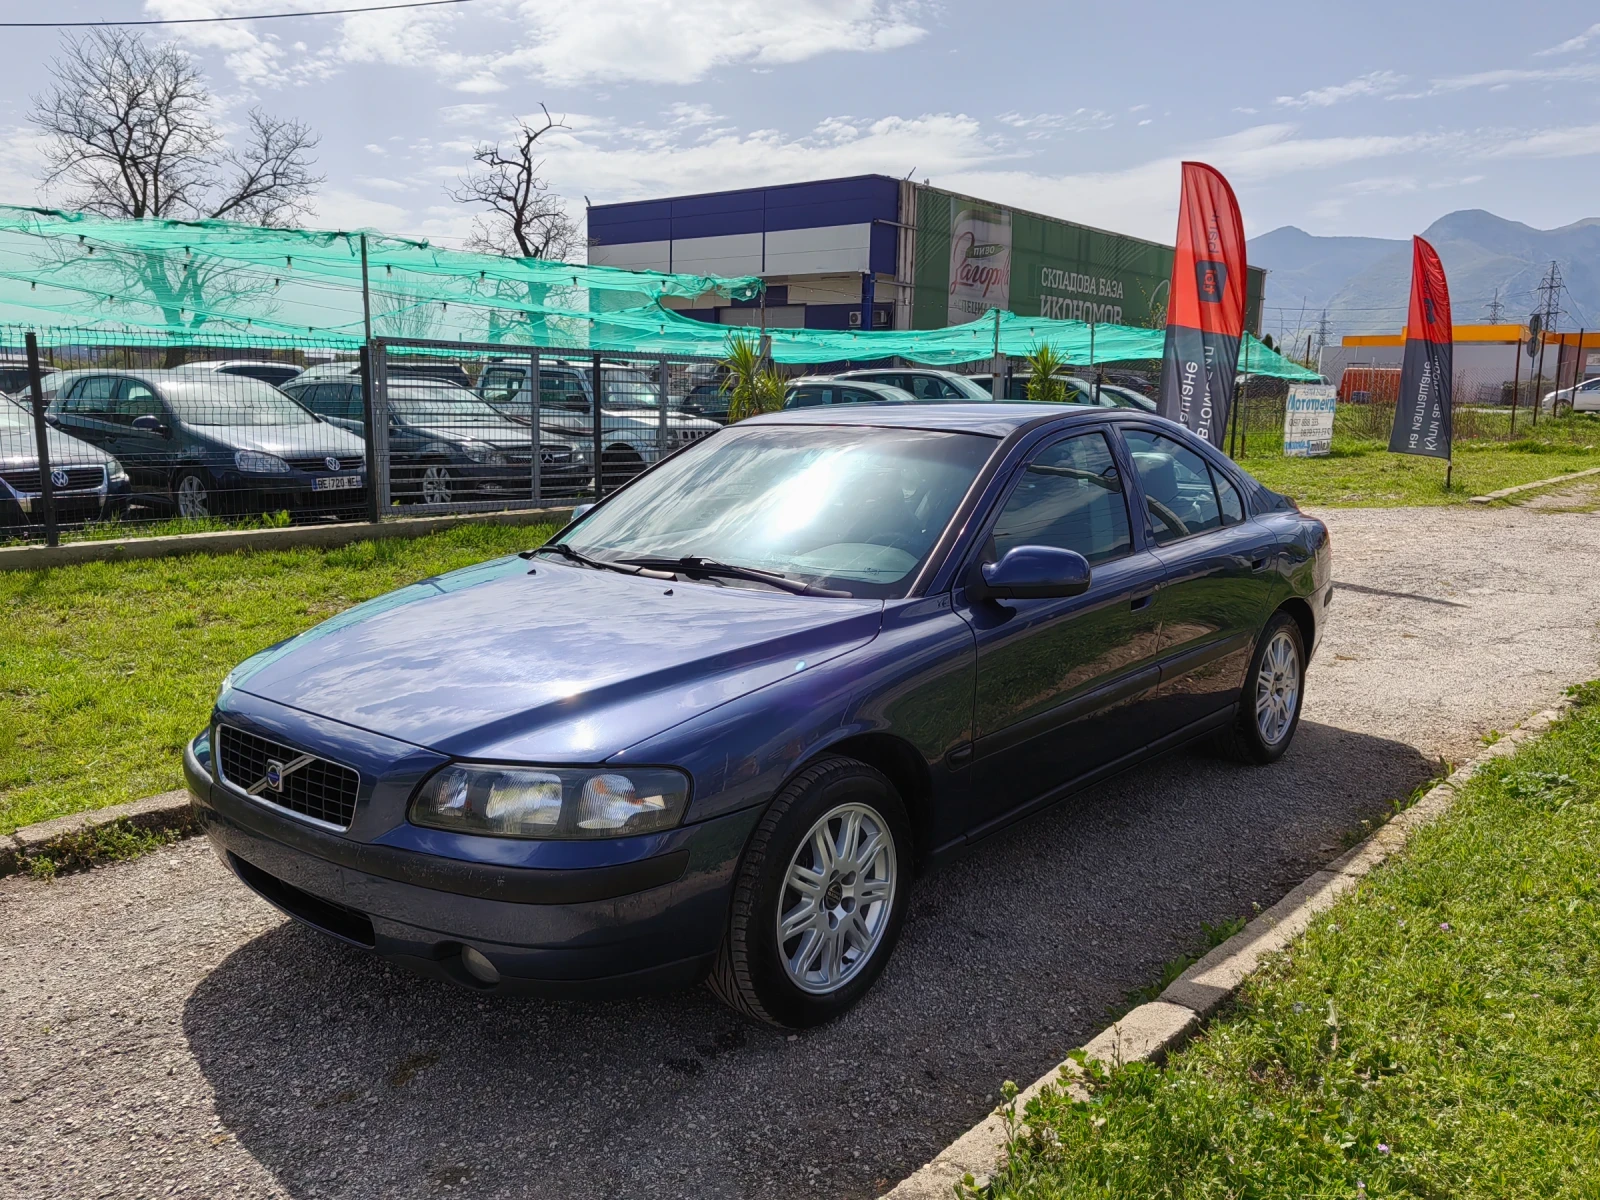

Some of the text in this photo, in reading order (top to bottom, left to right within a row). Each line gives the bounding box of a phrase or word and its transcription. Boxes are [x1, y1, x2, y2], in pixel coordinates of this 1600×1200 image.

[1041, 267, 1124, 299] СКЛАДОВА БАЗА
[1040, 294, 1123, 325] ИКОНОМОВ
